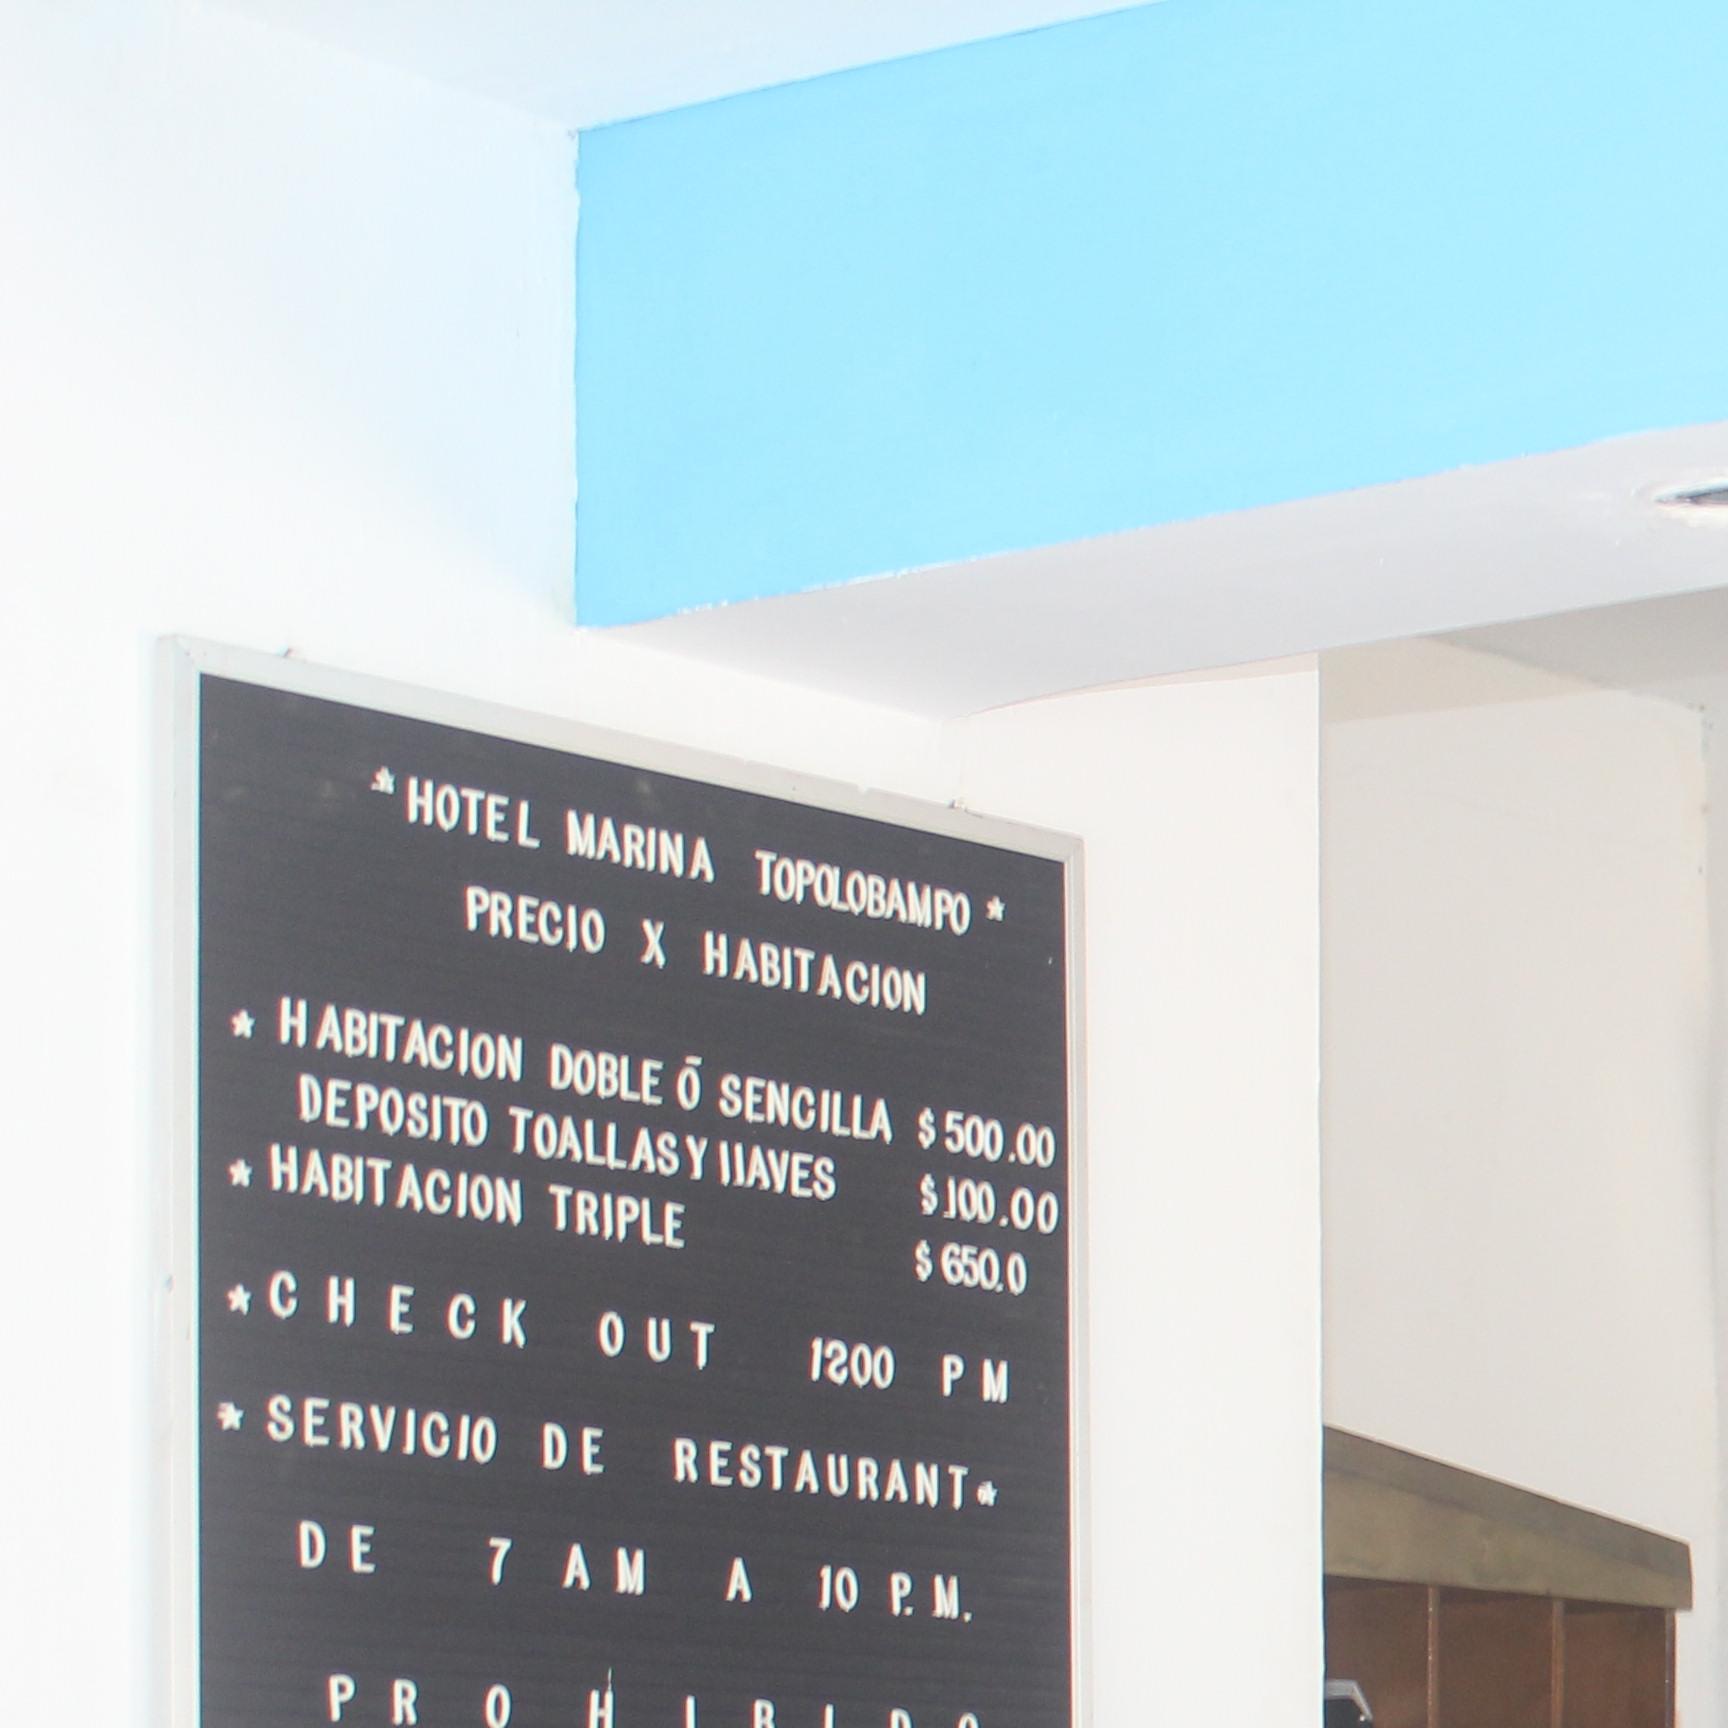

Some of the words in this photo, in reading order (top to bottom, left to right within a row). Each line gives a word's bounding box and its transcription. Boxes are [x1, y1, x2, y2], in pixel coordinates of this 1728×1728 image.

[407, 776, 540, 849] HOTEL
[566, 809, 715, 883] MARINA
[754, 849, 971, 936] TOPOLOBAMPO
[465, 885, 605, 954] PRECIO
[641, 919, 666, 969] X
[703, 930, 926, 1015] HABITACION
[279, 996, 523, 1082] HABITACION
[550, 1043, 663, 1106] DOBLE
[718, 1073, 893, 1145] SENCILLA
[299, 1073, 488, 1146] DEPOSITO
[508, 1106, 680, 1177] TOALLAS
[685, 1134, 708, 1180] Y
[270, 1143, 522, 1227] HABITACION
[548, 1184, 685, 1249] TRIPLE
[268, 1270, 526, 1349] CHECK
[599, 1311, 715, 1370] OUT
[266, 1394, 497, 1464] SERVICIO
[543, 1422, 604, 1475] DE
[674, 1437, 969, 1510] RESTAURANT
[299, 1520, 375, 1573] DE
[489, 1537, 512, 1585] 7
[726, 1557, 752, 1602] A
[819, 1565, 858, 1613] 10
